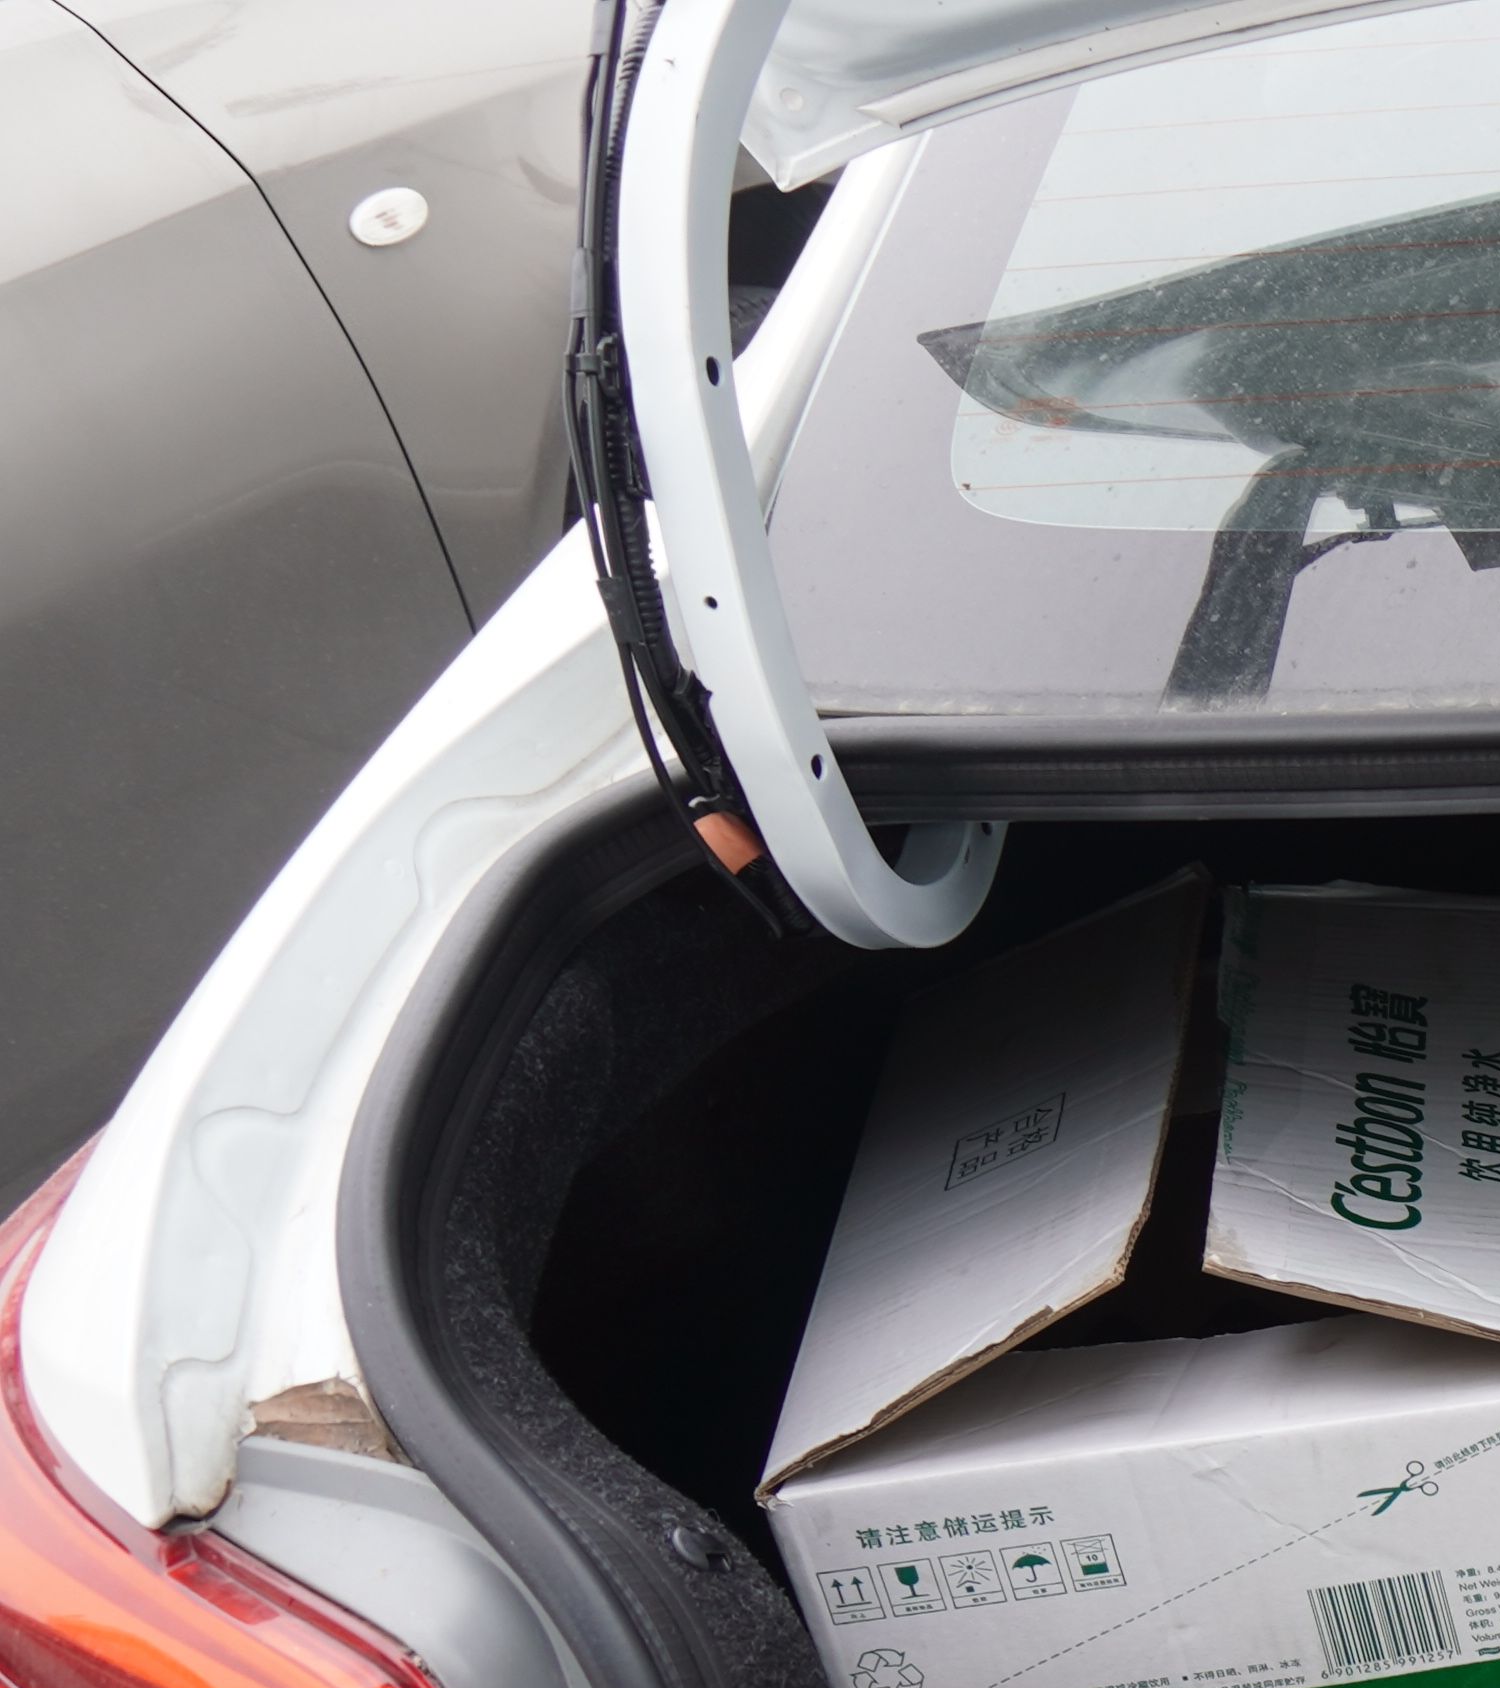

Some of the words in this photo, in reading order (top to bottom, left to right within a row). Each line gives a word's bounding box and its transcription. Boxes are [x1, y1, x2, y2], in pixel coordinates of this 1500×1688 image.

[956, 1128, 1005, 1180] 产品
[1007, 1108, 1054, 1157] 合格
[855, 1506, 1056, 1551] 请注意储运提示
[1458, 1582, 1478, 1593] Net
[1465, 1606, 1497, 1618] Gross
